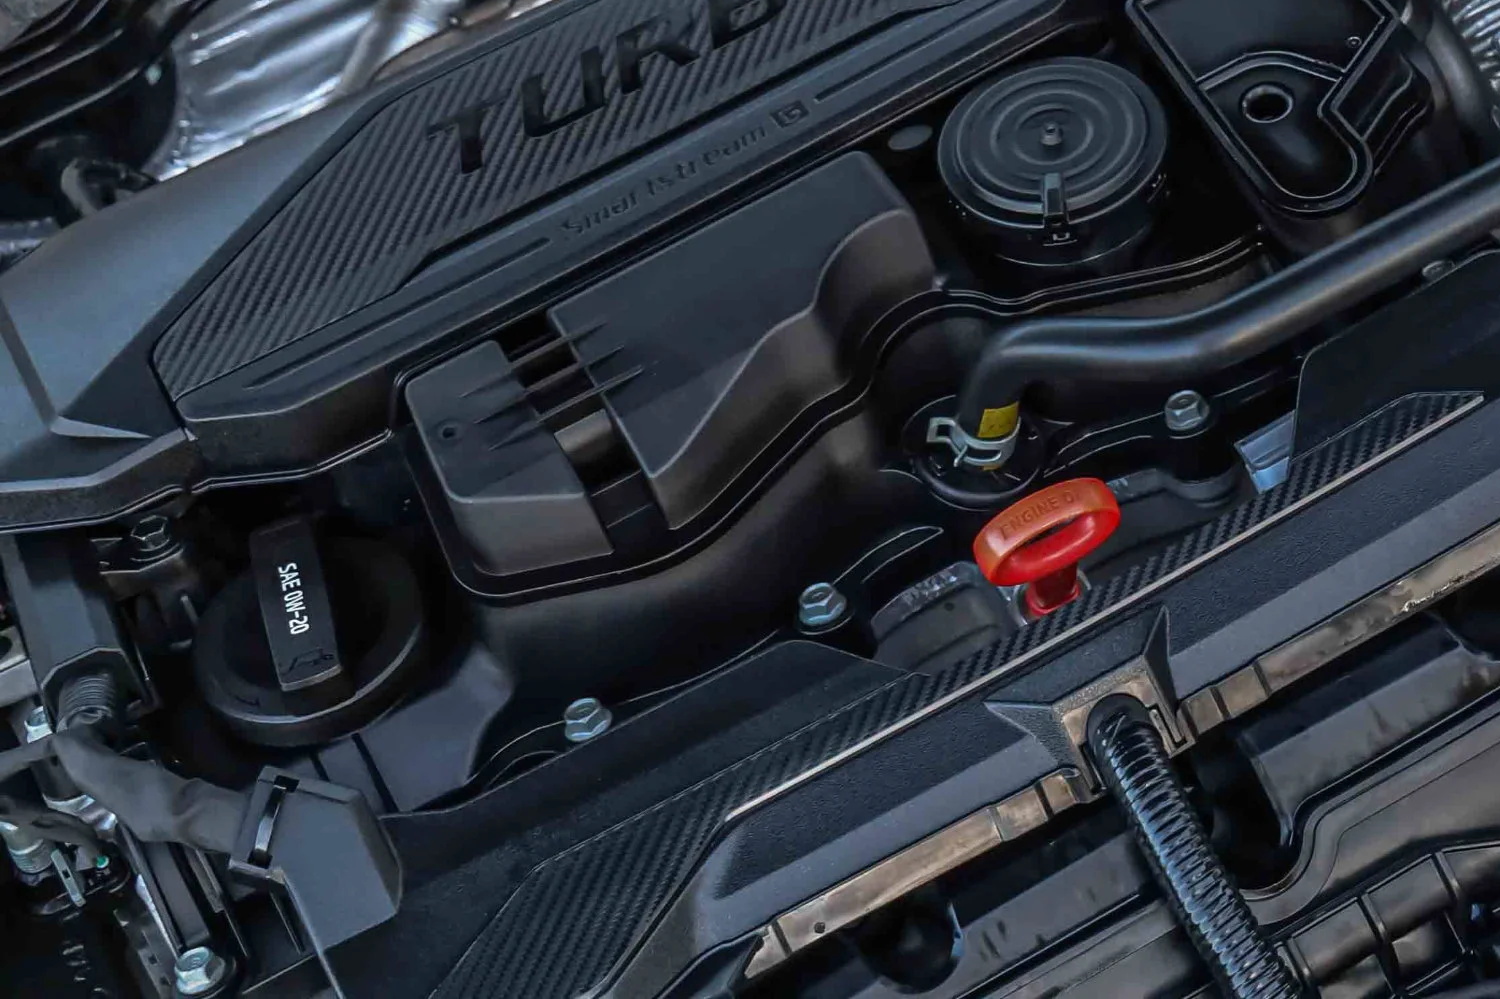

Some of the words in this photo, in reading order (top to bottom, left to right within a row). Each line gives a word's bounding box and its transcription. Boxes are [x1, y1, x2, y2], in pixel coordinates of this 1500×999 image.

[561, 124, 766, 241] Smartstream
[999, 496, 1060, 539] ENGINE
[278, 562, 301, 592] SAE
[284, 590, 310, 635] 0W-20
